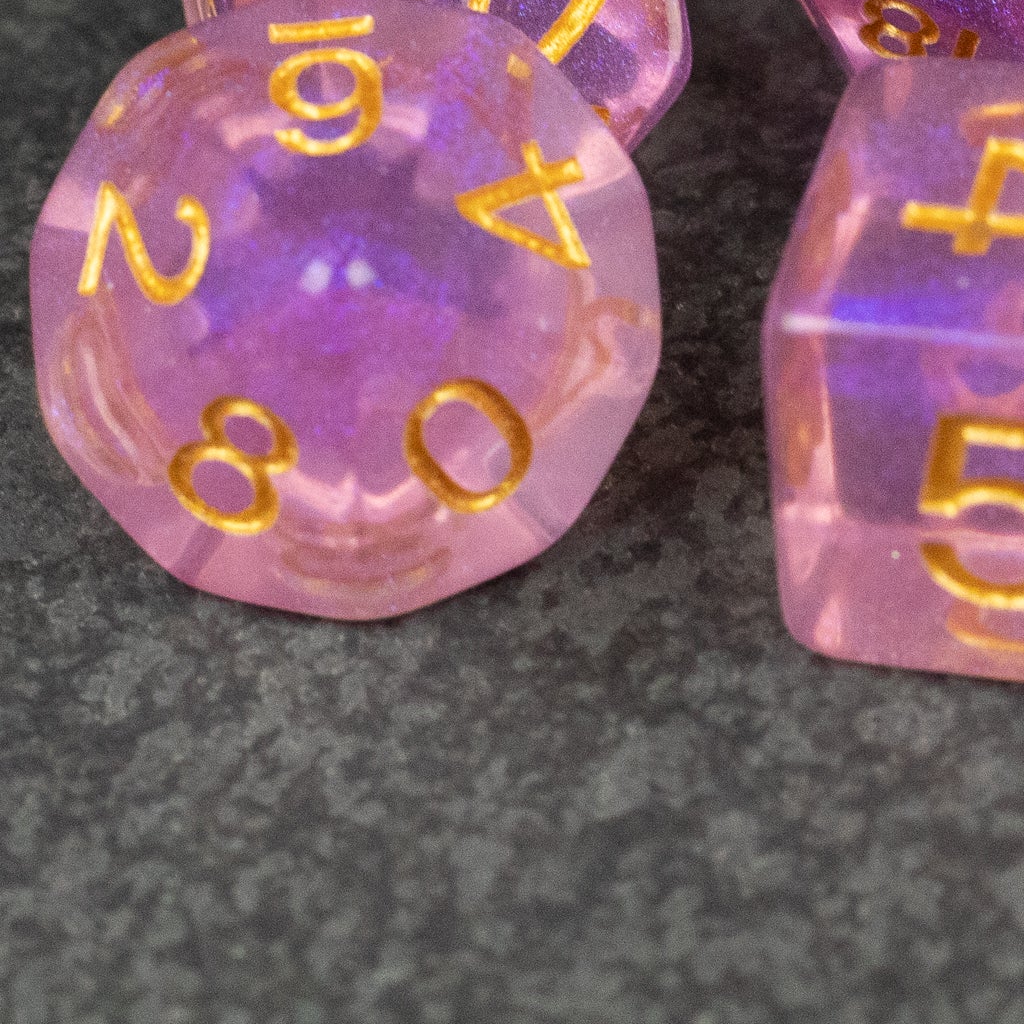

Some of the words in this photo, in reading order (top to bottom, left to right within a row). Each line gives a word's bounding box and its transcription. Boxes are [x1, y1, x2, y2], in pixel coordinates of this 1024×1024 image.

[268, 13, 384, 157] 6
[77, 181, 211, 306] 2
[455, 140, 592, 269] 4
[168, 394, 299, 536] 8
[404, 377, 535, 515] 0
